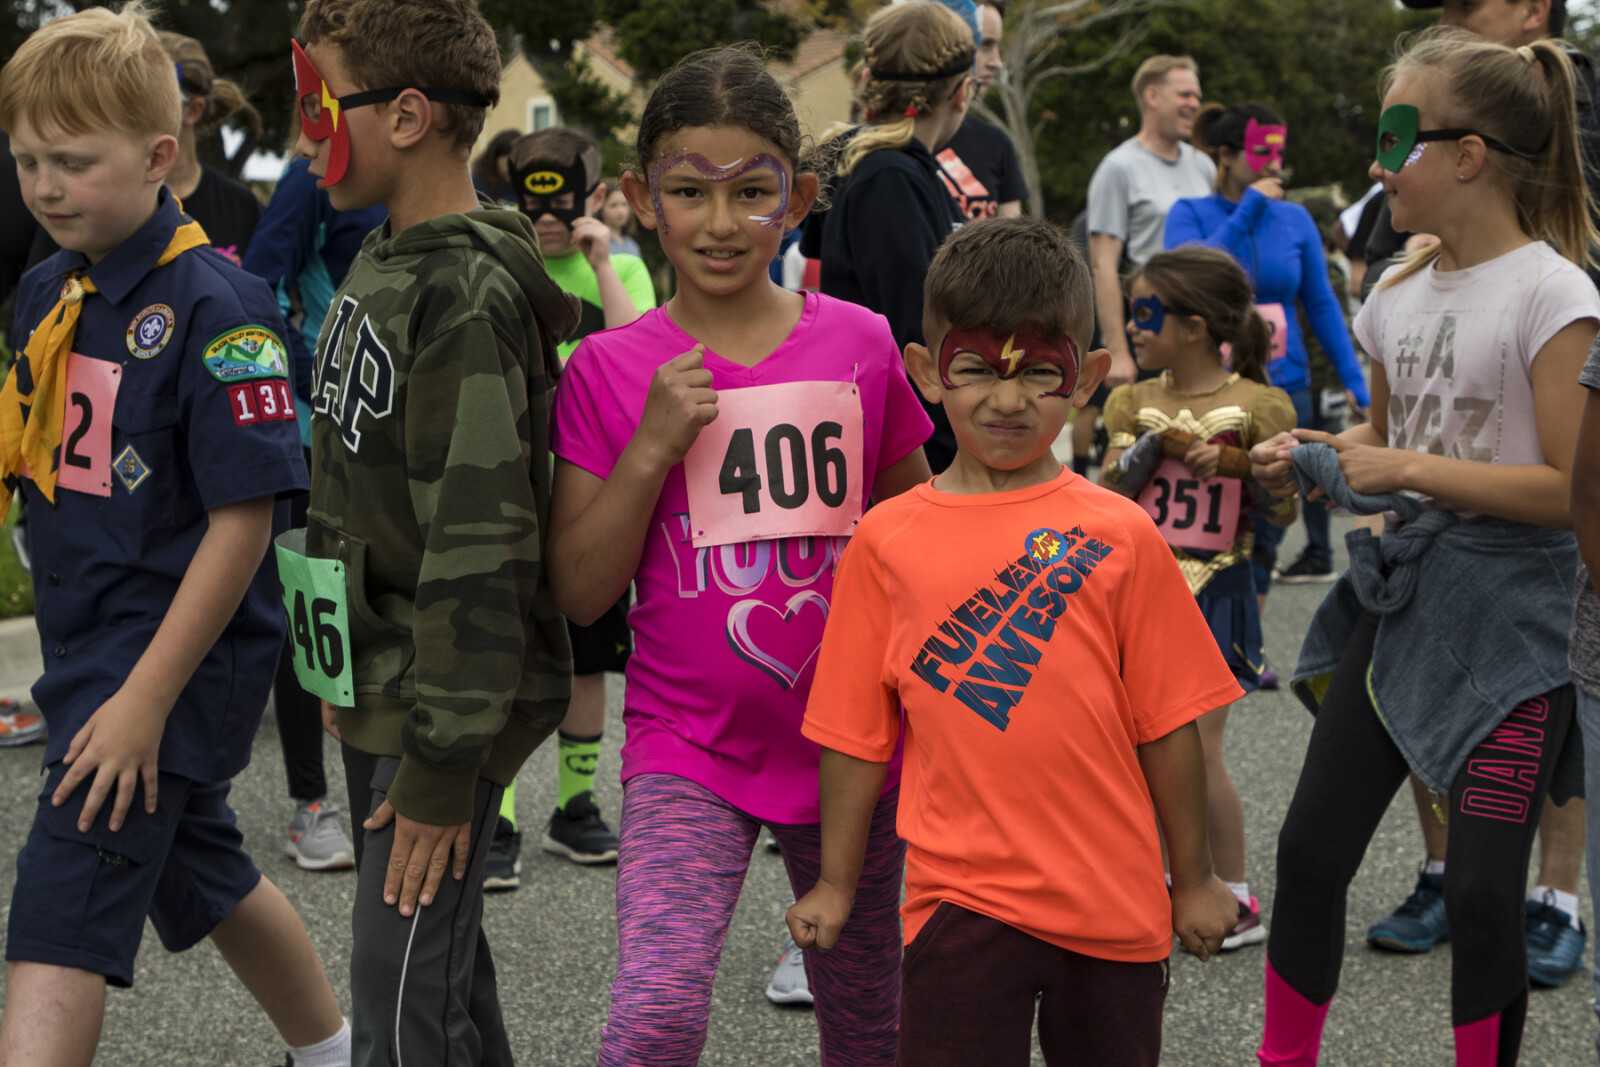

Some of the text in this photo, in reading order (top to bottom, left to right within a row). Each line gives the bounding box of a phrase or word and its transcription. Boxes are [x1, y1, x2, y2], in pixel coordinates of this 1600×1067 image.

[236, 386, 293, 421] 131
[719, 421, 847, 514] 406
[1153, 477, 1223, 534] 351
[281, 580, 344, 678] 46
[951, 537, 1114, 733] AWESOME
